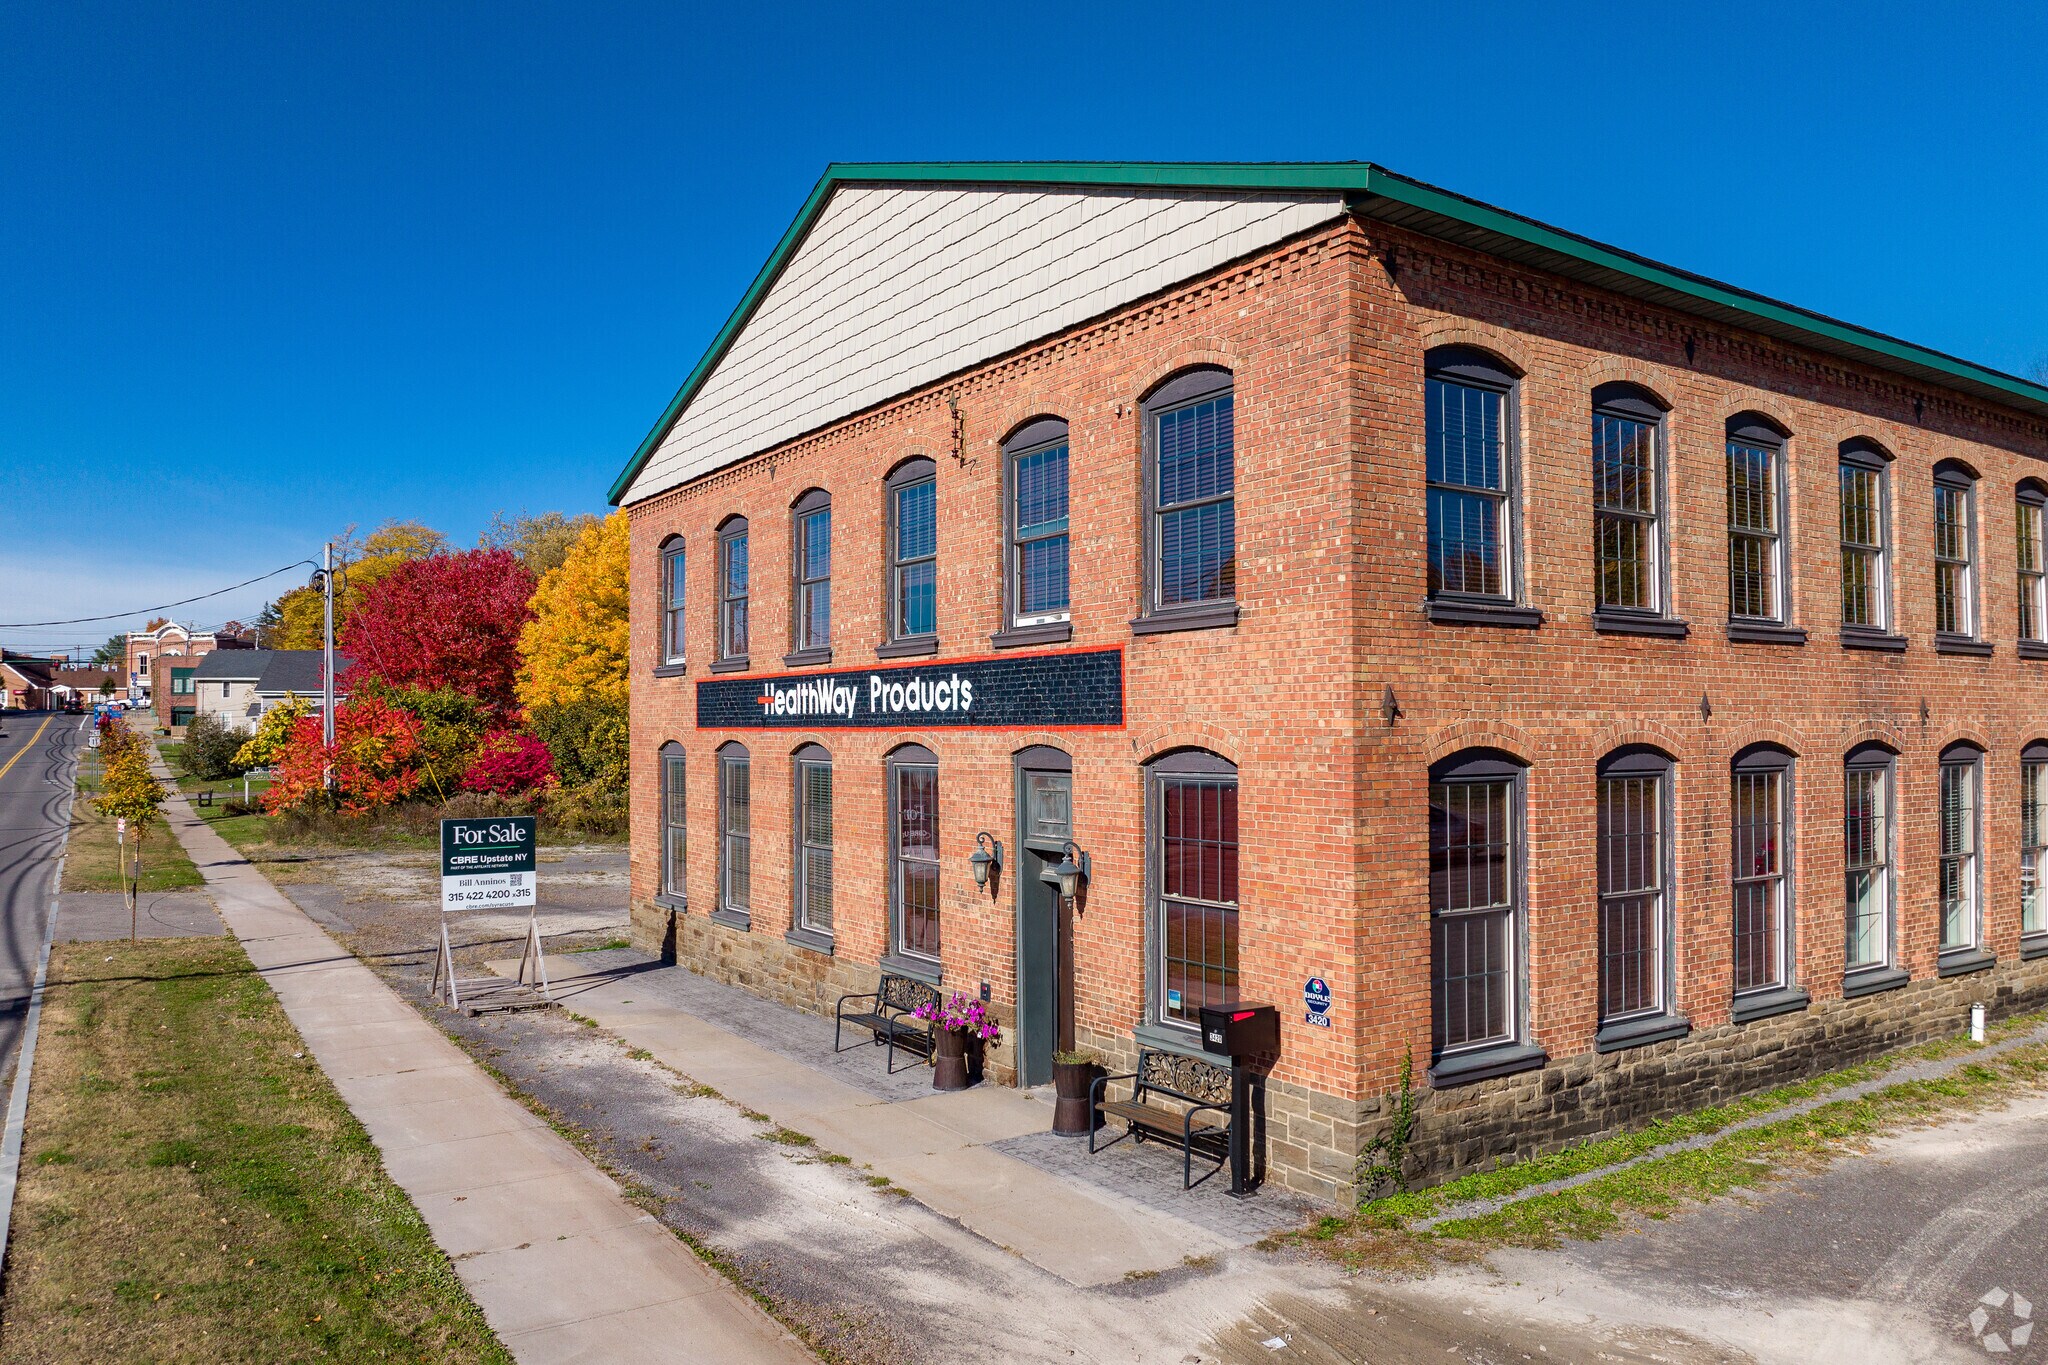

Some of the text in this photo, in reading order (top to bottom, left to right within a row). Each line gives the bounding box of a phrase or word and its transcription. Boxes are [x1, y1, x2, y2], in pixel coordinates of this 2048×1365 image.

[758, 673, 973, 718] HealthWay Products
[453, 823, 526, 844] For Sale
[450, 853, 527, 864] CBRE Upstate NY
[459, 878, 506, 887] Bill Anninos
[448, 889, 531, 902] 315 422 4200 x315
[1305, 992, 1330, 1003] DOYLE
[1308, 1014, 1328, 1026] 3420
